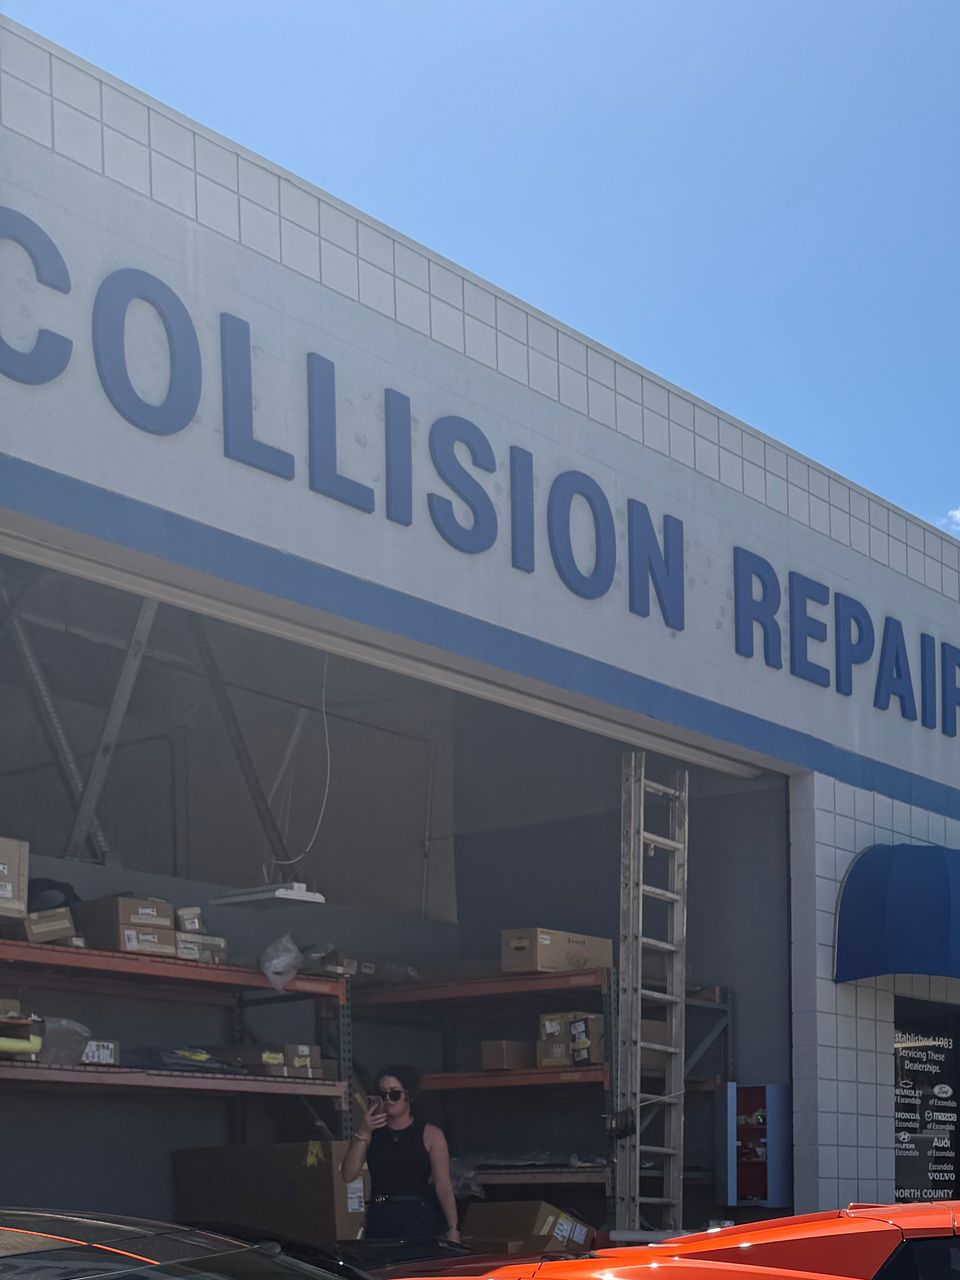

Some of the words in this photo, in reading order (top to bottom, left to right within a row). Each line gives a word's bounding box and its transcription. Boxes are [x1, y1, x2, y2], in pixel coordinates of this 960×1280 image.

[0, 206, 686, 632] COLLISION
[895, 1032, 933, 1045] stablished
[935, 1036, 953, 1049] 1983
[928, 1050, 945, 1061] These
[894, 1189, 920, 1198] NORTH
[922, 1189, 953, 1198] COUNTY
